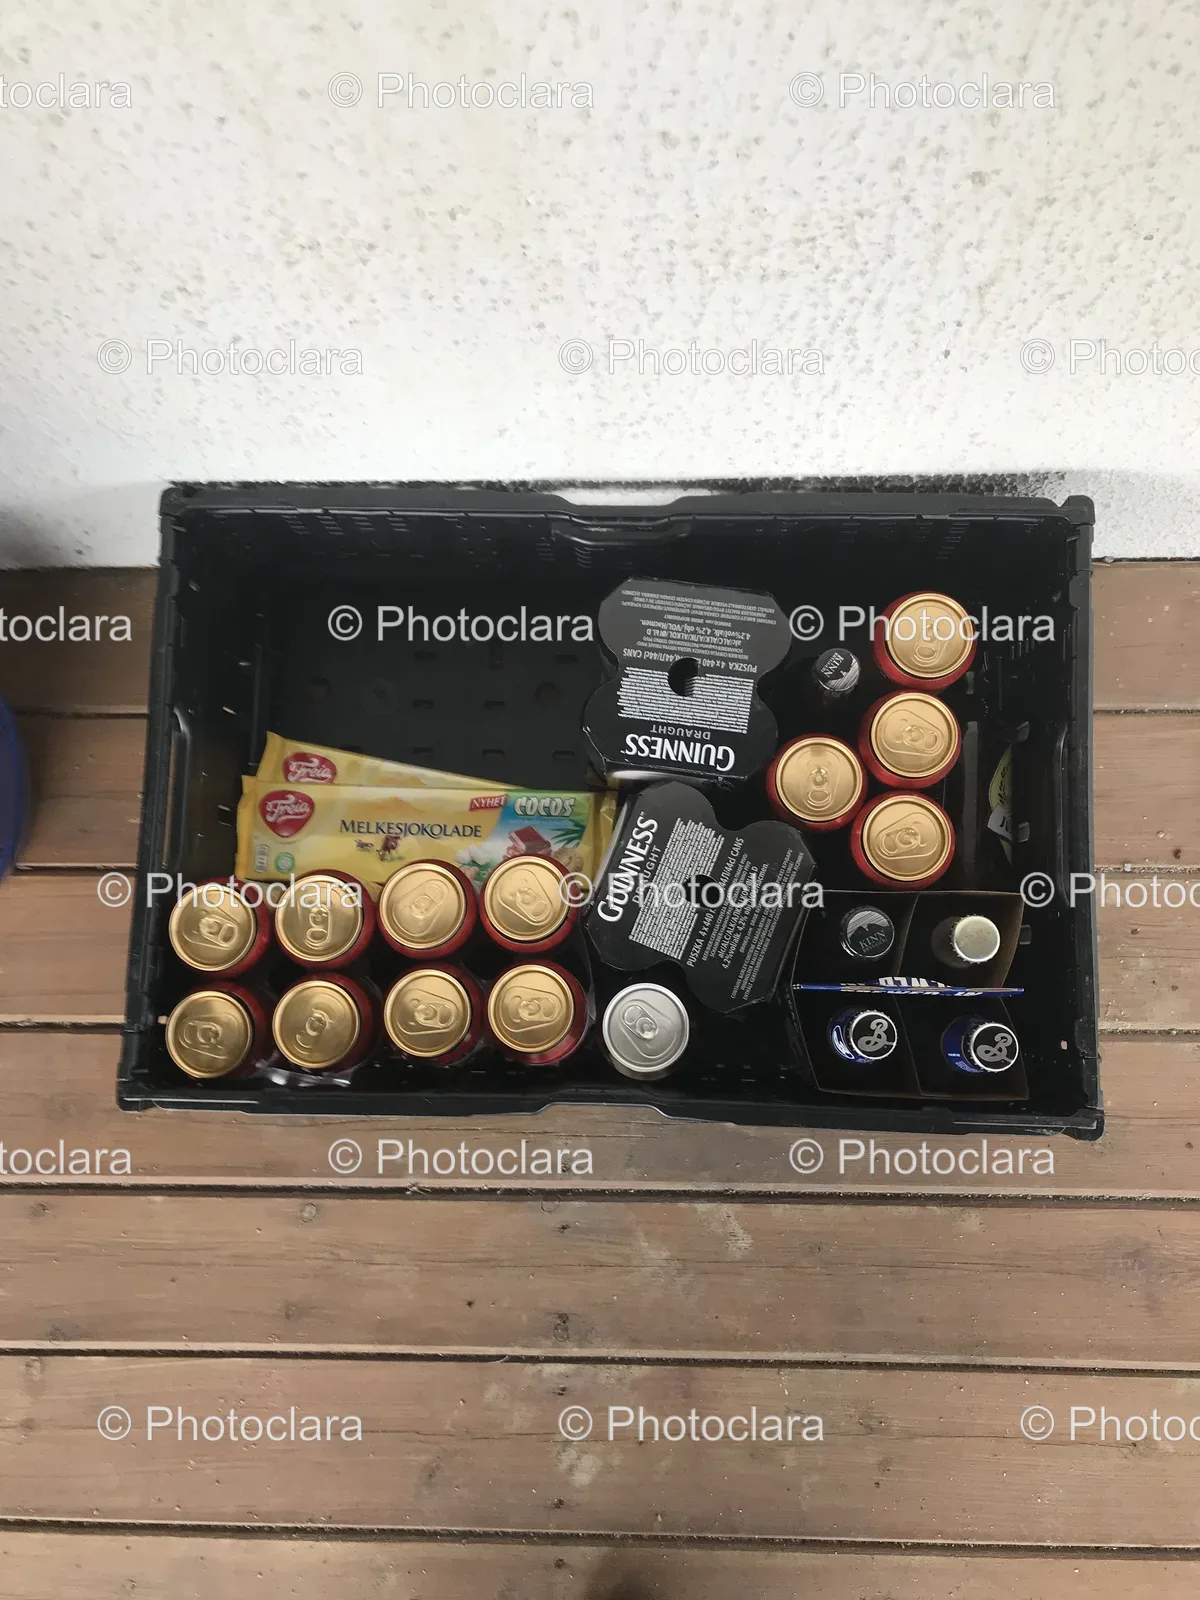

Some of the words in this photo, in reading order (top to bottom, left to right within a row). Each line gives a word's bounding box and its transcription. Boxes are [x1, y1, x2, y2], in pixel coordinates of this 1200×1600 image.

[622, 647, 642, 658] CANS
[728, 661, 757, 673] PUSZKA
[823, 653, 844, 677] KINN
[649, 724, 711, 740] DRAUGHT
[265, 794, 311, 823] Freia
[472, 795, 506, 809] NYHET
[514, 796, 577, 817] COCOS
[340, 819, 482, 840] MELKESJOKOLADE
[686, 938, 704, 967] PUSZKA
[730, 837, 744, 857] CANS
[859, 930, 887, 949] KINN
